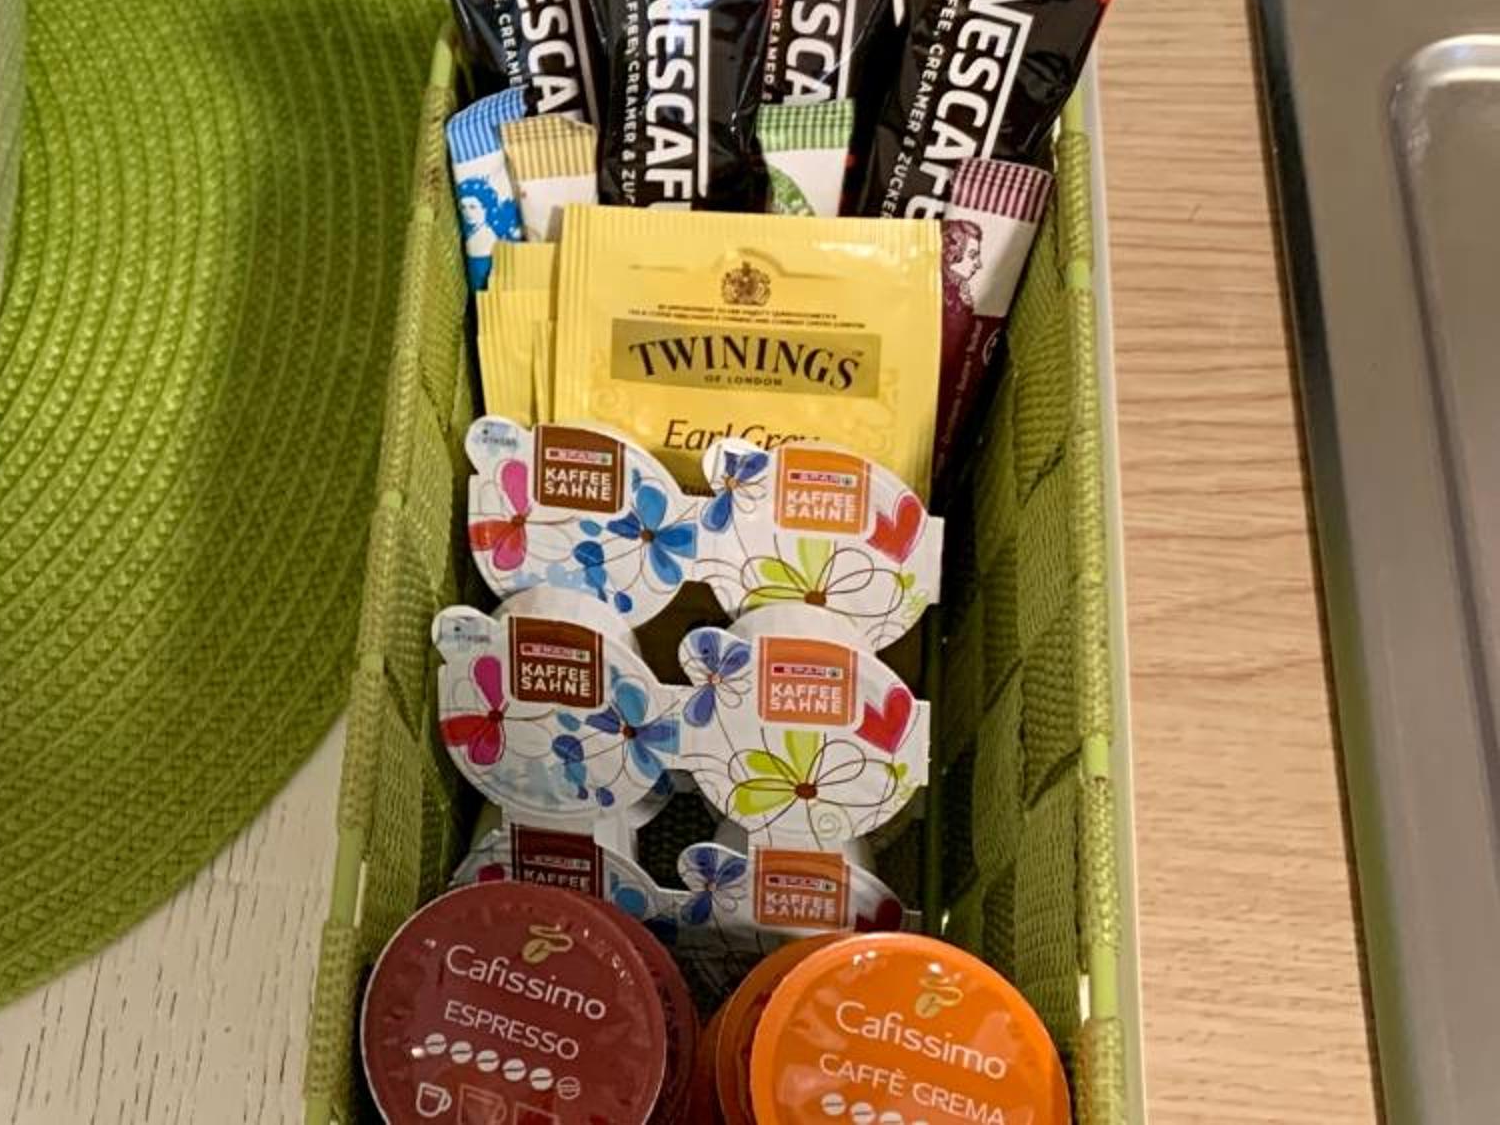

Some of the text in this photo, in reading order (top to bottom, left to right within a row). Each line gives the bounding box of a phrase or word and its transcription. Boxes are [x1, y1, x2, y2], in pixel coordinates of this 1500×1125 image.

[498, 14, 523, 88] CREAME
[907, 44, 944, 132] CREAMER
[622, 60, 641, 143] CREAMER
[629, 334, 861, 391] TWININGS
[703, 375, 783, 386] OF LONDON
[545, 467, 612, 487] KAFFEE
[545, 481, 612, 502] SAHNE
[786, 490, 857, 507] KAFFEE
[785, 505, 857, 523] SAHNE
[521, 662, 590, 682] KAFFEE
[521, 677, 591, 697] SAHNE
[771, 682, 842, 700] KAFFEE
[770, 698, 842, 714] SAHNE
[446, 944, 606, 1020] Cafissimo
[443, 999, 579, 1061] ESPRESSO
[835, 1000, 1007, 1080] Cafissimo
[819, 1053, 1005, 1125] CAFFÈ CREMA
